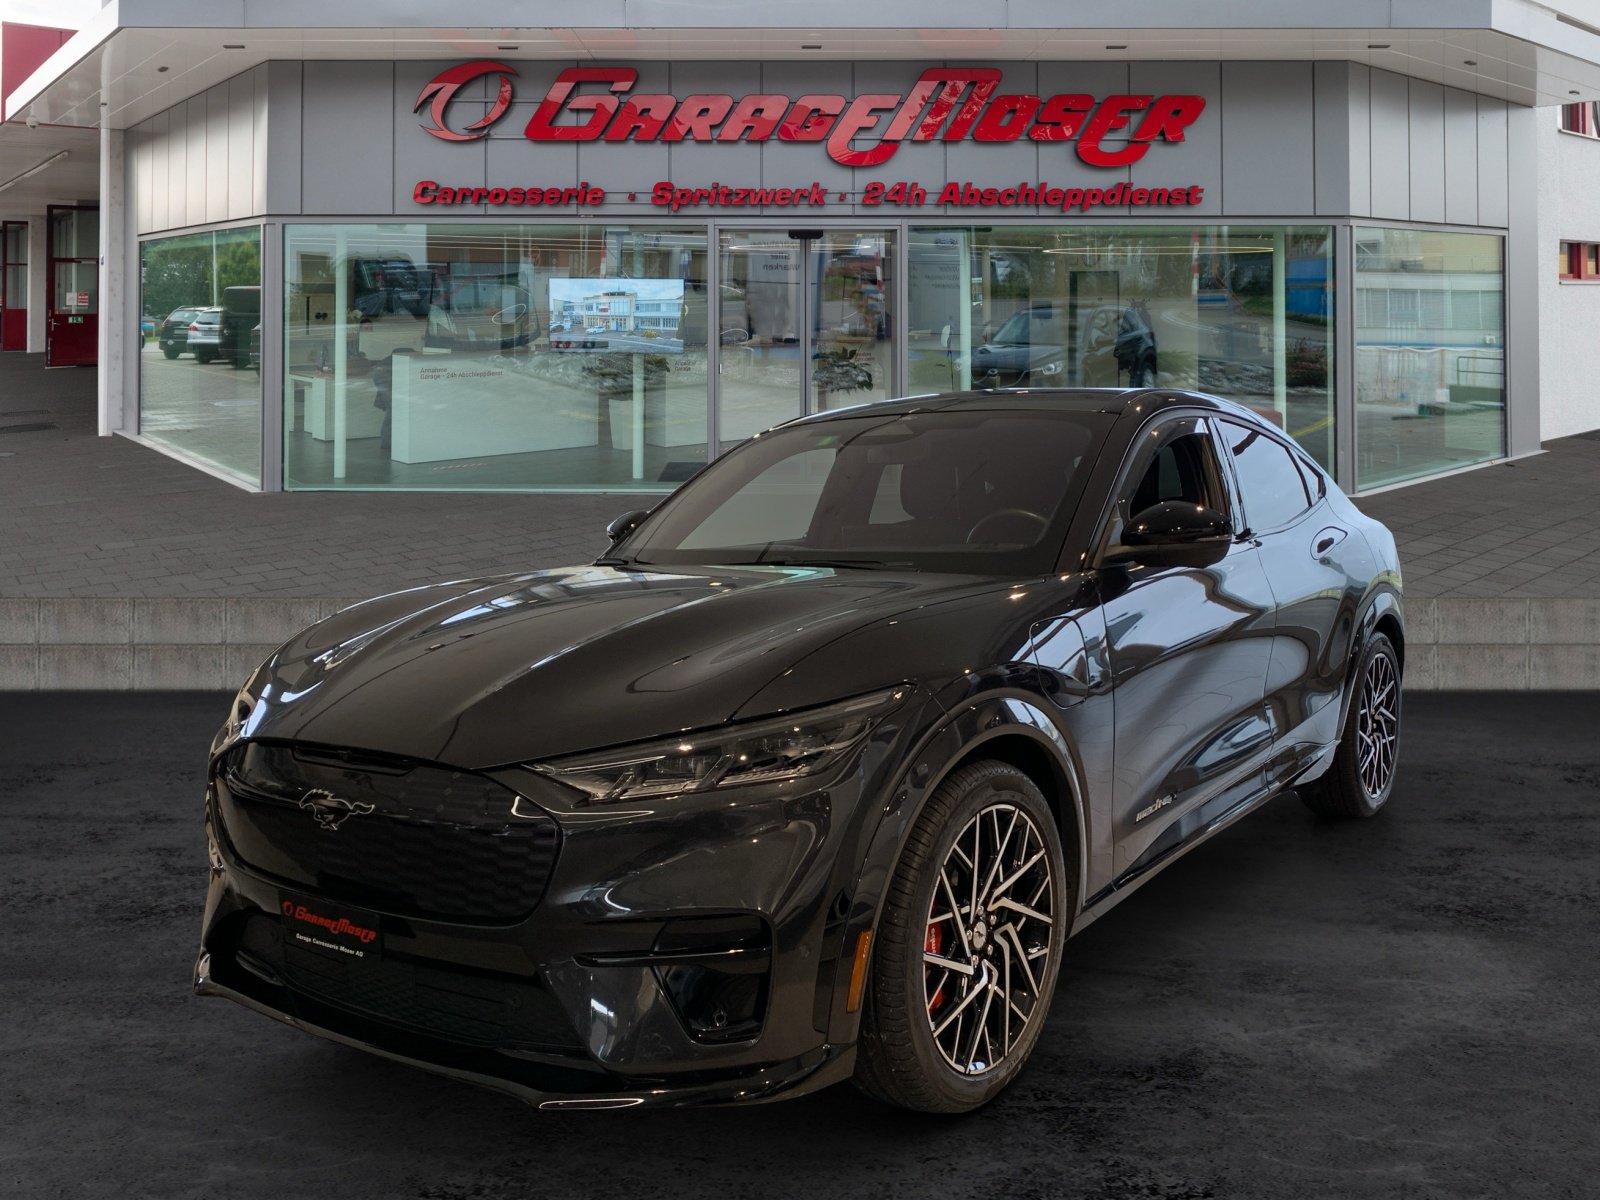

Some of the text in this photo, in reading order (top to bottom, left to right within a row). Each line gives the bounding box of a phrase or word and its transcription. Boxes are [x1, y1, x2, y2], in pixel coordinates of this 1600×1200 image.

[413, 181, 1204, 212] Carrosserie Spritzwerk 24h Abschleppdienst
[295, 932, 312, 943] Garage
[340, 945, 355, 955] Moser
[355, 950, 364, 958] AG
